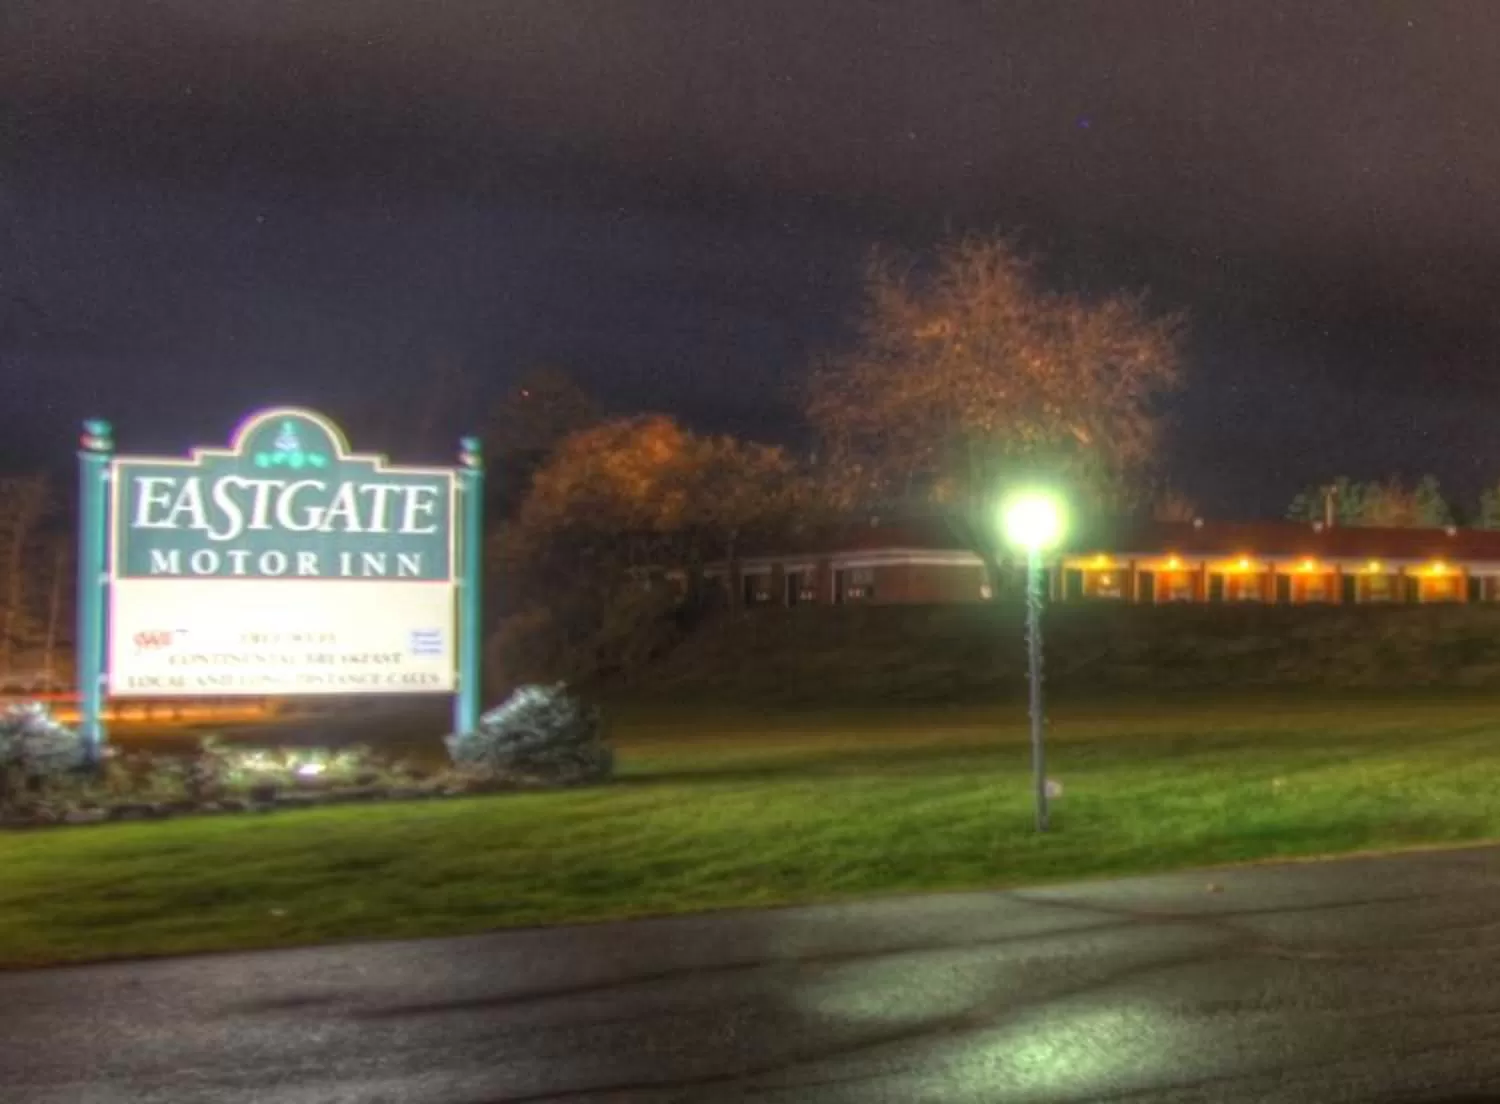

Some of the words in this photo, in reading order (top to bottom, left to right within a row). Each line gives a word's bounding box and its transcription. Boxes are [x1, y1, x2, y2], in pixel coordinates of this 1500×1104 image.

[132, 474, 438, 541] EASTGATE
[149, 549, 319, 575] MOTOR
[341, 551, 422, 577] INN
